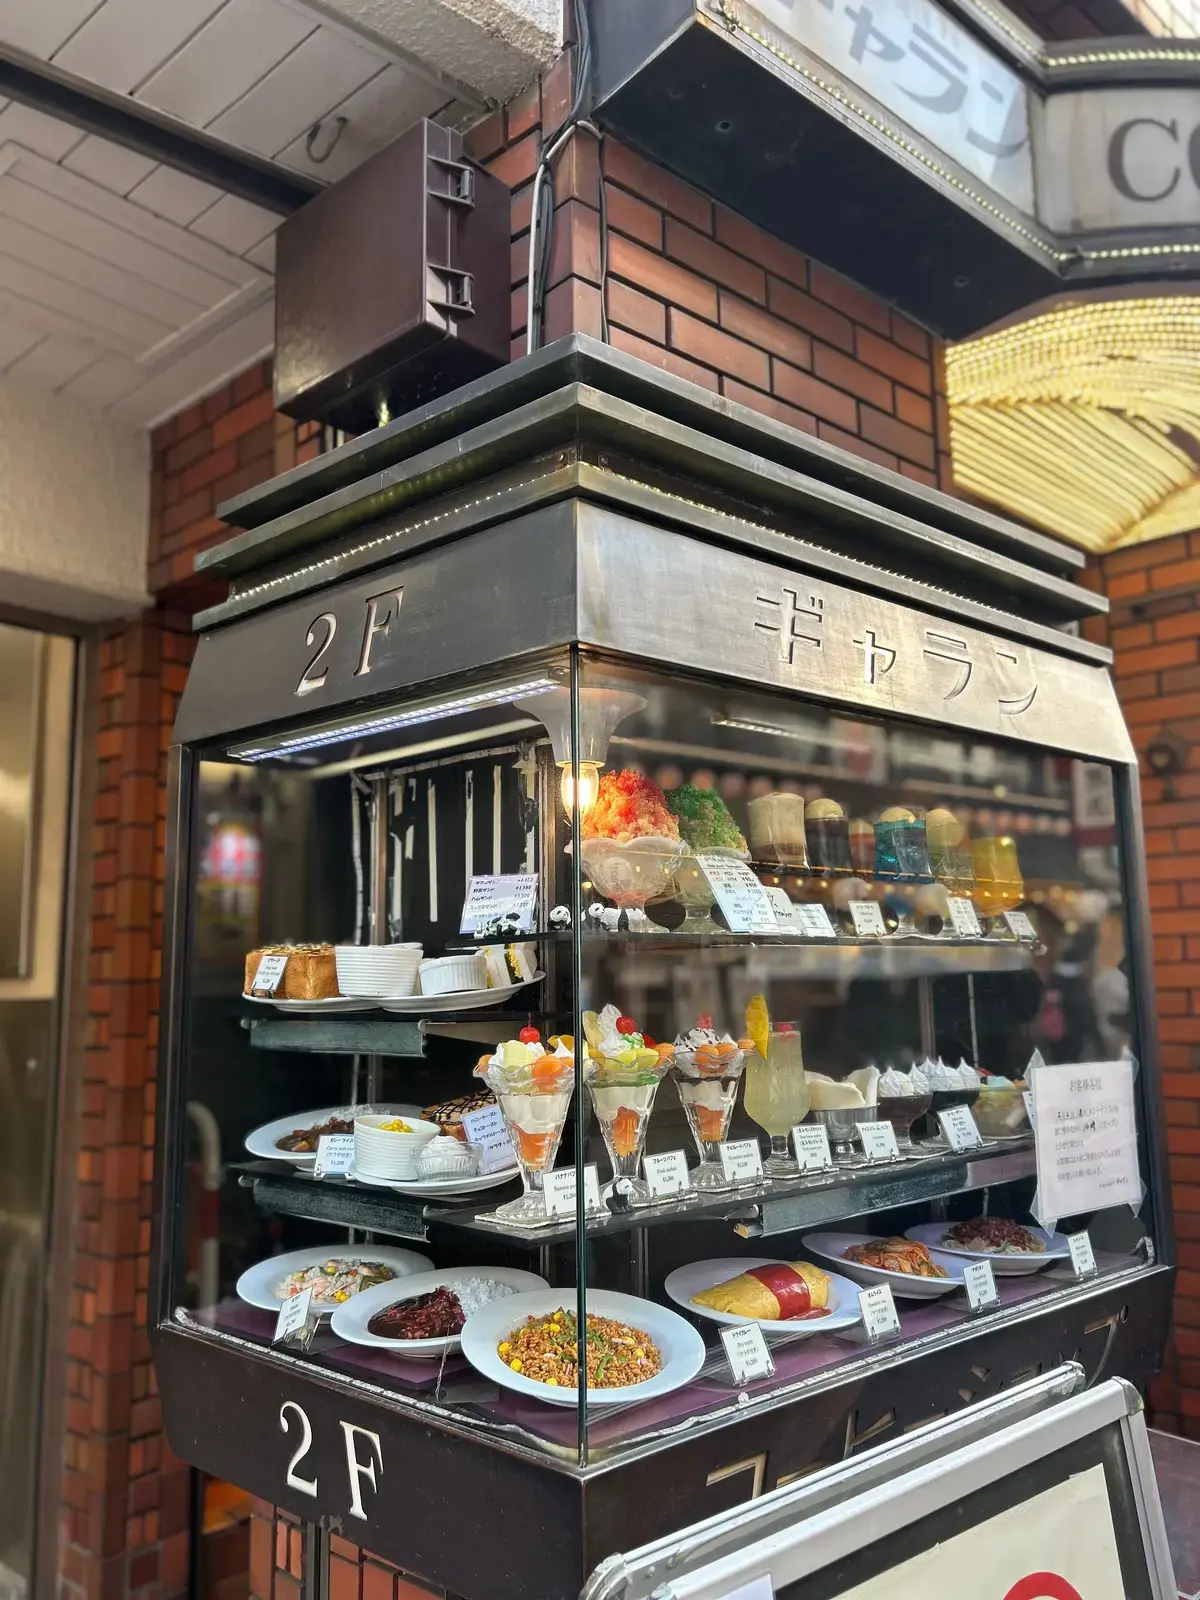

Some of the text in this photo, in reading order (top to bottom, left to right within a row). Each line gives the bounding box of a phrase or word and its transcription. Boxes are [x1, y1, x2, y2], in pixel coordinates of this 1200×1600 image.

[778, 0, 1028, 158] ャラン
[1107, 118, 1200, 203] C
[294, 585, 403, 696] 2F
[755, 587, 1038, 716] ギャラン
[653, 1155, 676, 1164] フルーツパフェ
[732, 1329, 751, 1338] ドライカレー
[868, 1289, 882, 1298] オムライス
[279, 1400, 384, 1521] 2F
